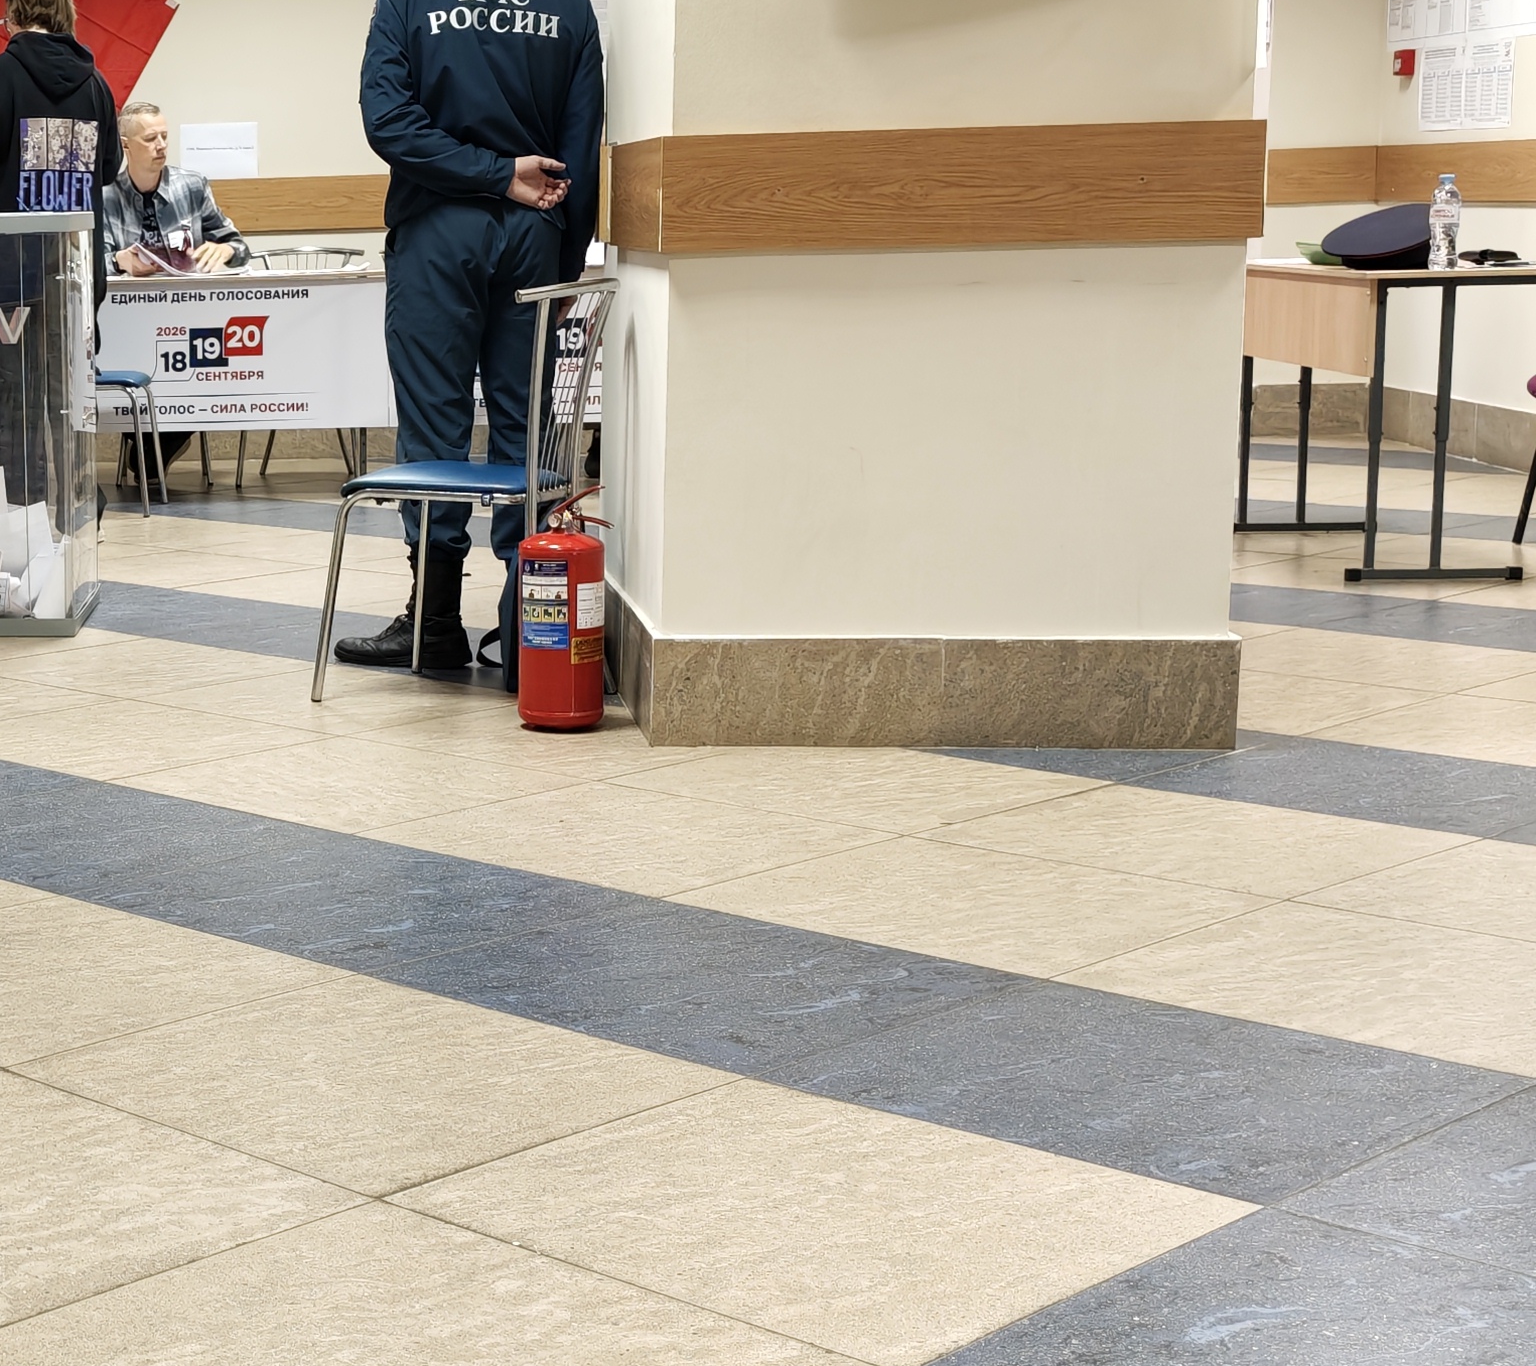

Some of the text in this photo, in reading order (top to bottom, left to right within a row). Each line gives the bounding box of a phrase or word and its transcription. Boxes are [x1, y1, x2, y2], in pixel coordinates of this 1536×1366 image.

[427, 6, 561, 39] РОССИИ
[18, 171, 94, 212] FLOWER
[111, 288, 309, 305] ЕДИНЫЙ ДЕНЬ ГОЛОСОВАНИЯ
[156, 327, 187, 337] 2026
[556, 327, 585, 351] 19
[160, 324, 261, 373] 18 19 20
[196, 370, 264, 382] СЕНТЯБРЯ
[210, 404, 246, 414] СИЛА
[250, 402, 309, 413] РОССИИ!
